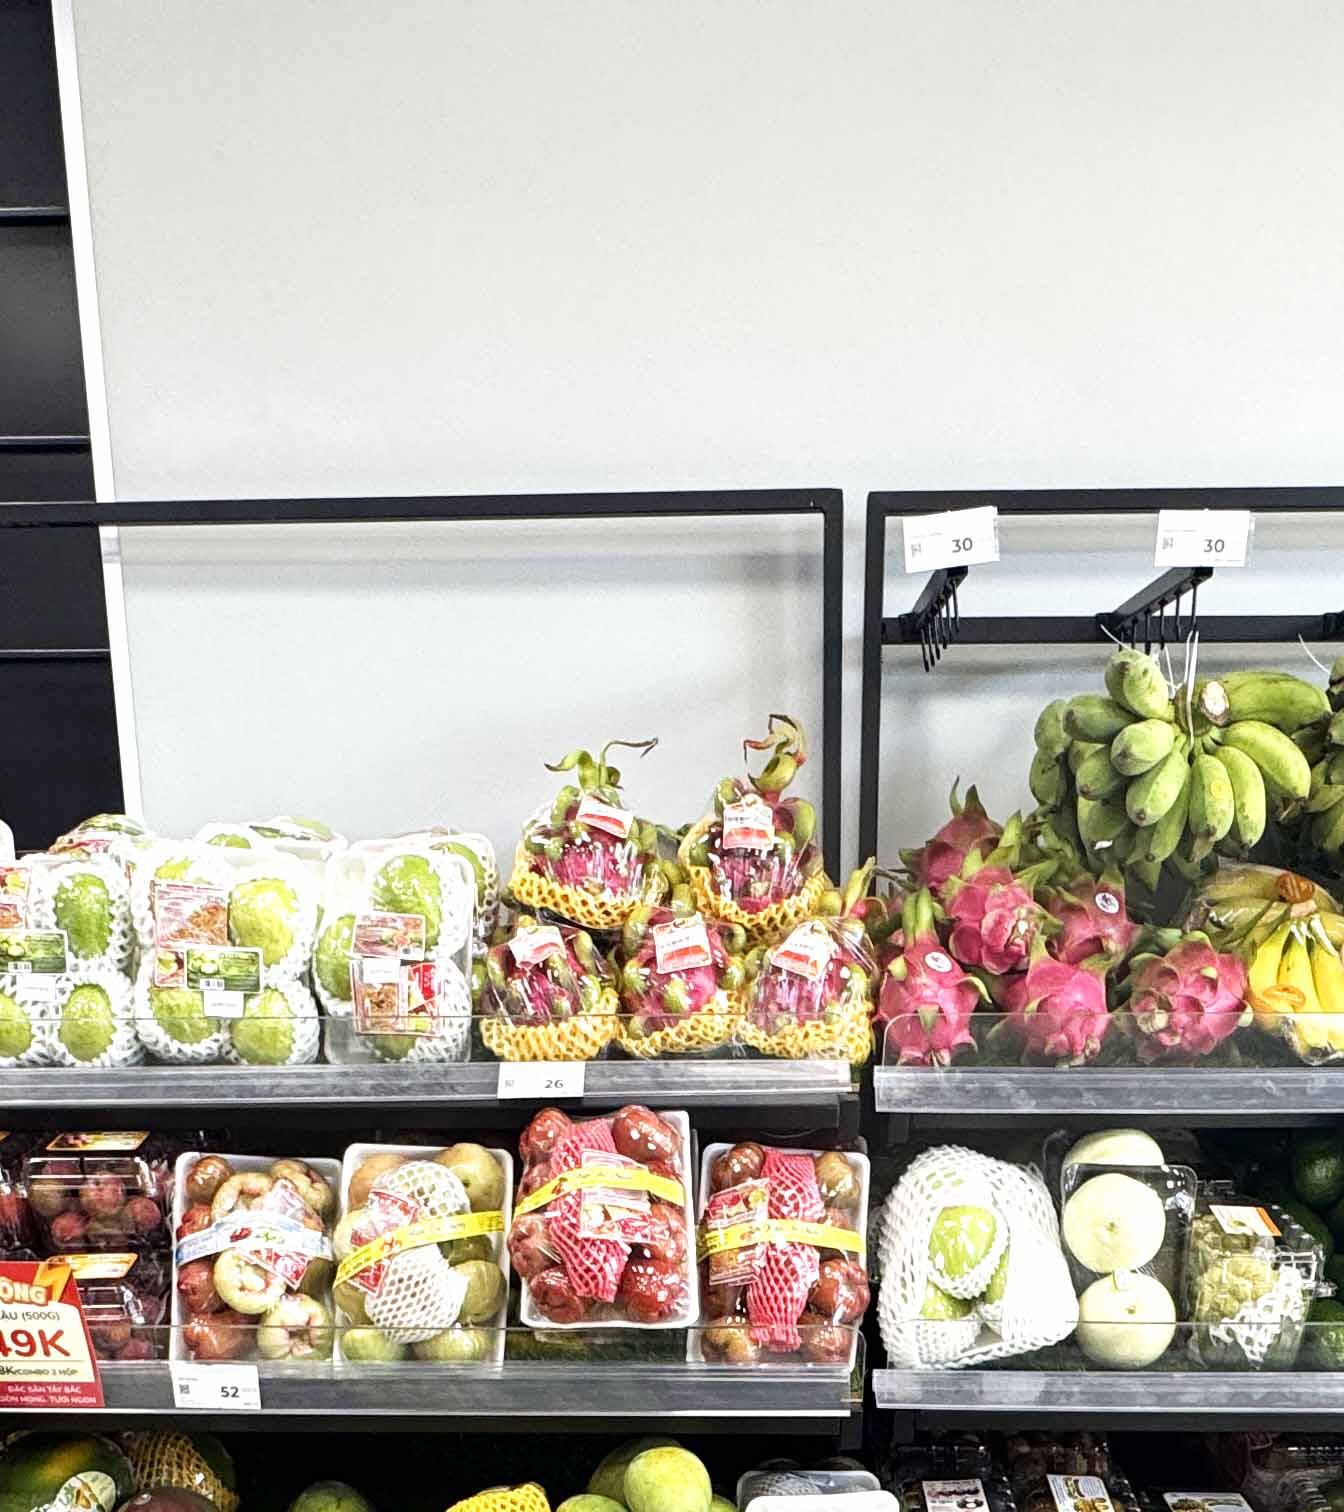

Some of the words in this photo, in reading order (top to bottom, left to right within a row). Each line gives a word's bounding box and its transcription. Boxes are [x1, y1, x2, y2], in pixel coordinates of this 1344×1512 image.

[951, 537, 974, 553] 30
[1203, 537, 1226, 554] 30
[220, 1385, 240, 1398] 52
